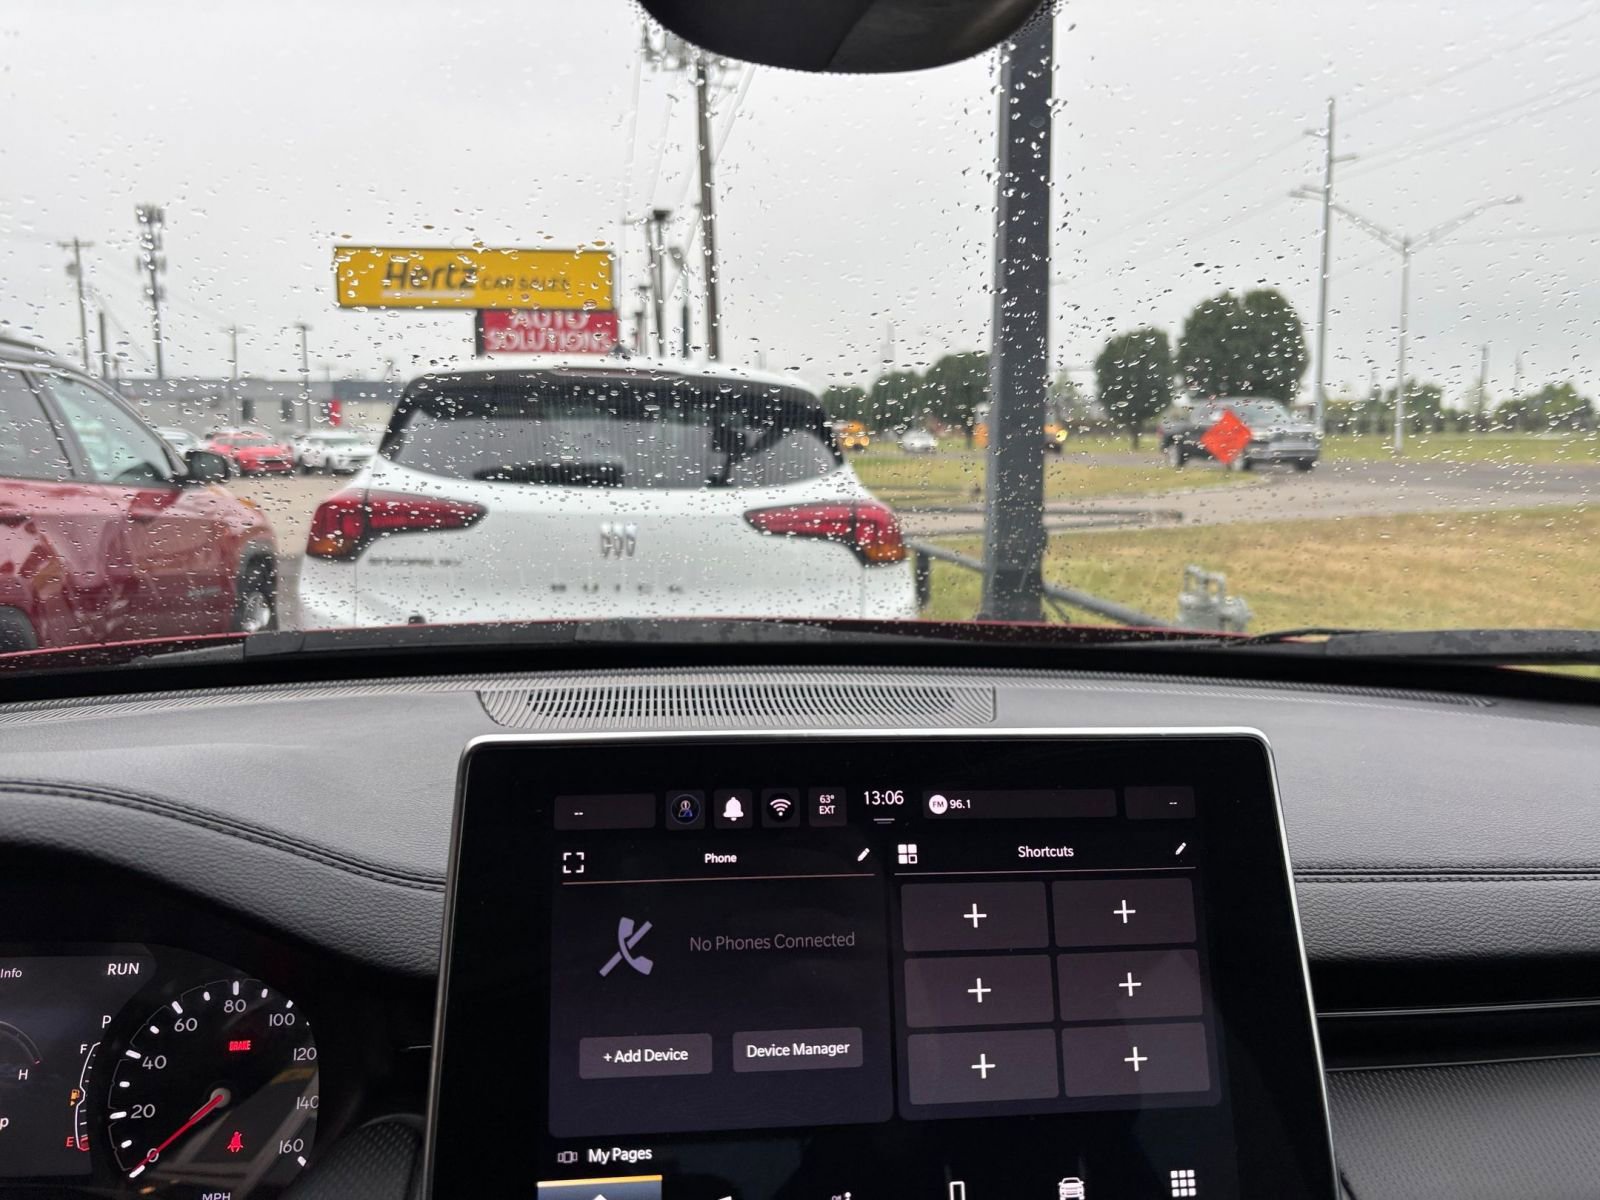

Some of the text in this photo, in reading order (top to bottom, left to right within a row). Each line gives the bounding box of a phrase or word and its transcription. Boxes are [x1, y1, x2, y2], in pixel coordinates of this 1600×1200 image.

[382, 258, 477, 290] Hertz
[480, 276, 514, 290] CAR
[511, 310, 589, 330] AUTO
[484, 327, 615, 352] SOLUTIONS
[864, 791, 904, 805] 13:06
[950, 800, 970, 808] 96.1
[819, 805, 835, 815] EXT
[705, 853, 737, 863] Phone
[1018, 846, 1074, 857] Shortcuts
[691, 932, 854, 951] No Phones Connected
[0, 967, 23, 978] Info
[107, 962, 140, 976] RUN
[224, 999, 246, 1012] 80
[102, 1015, 111, 1028] P
[175, 1018, 197, 1032] 60
[270, 1013, 295, 1026] 100
[80, 1044, 88, 1054] F
[229, 1039, 251, 1051] BRAKE
[747, 1042, 850, 1058] Device Manager
[294, 1048, 316, 1060] 120
[614, 1049, 641, 1063] Add
[645, 1048, 688, 1062] Device
[142, 1054, 167, 1070] 40
[19, 1069, 28, 1080] H
[297, 1096, 318, 1109] 140
[131, 1104, 155, 1118] 20
[66, 1136, 74, 1147] E
[279, 1139, 303, 1154] 160
[147, 1148, 159, 1163] 0
[589, 1148, 652, 1164] My Pages
[202, 1192, 231, 1200] MPH
